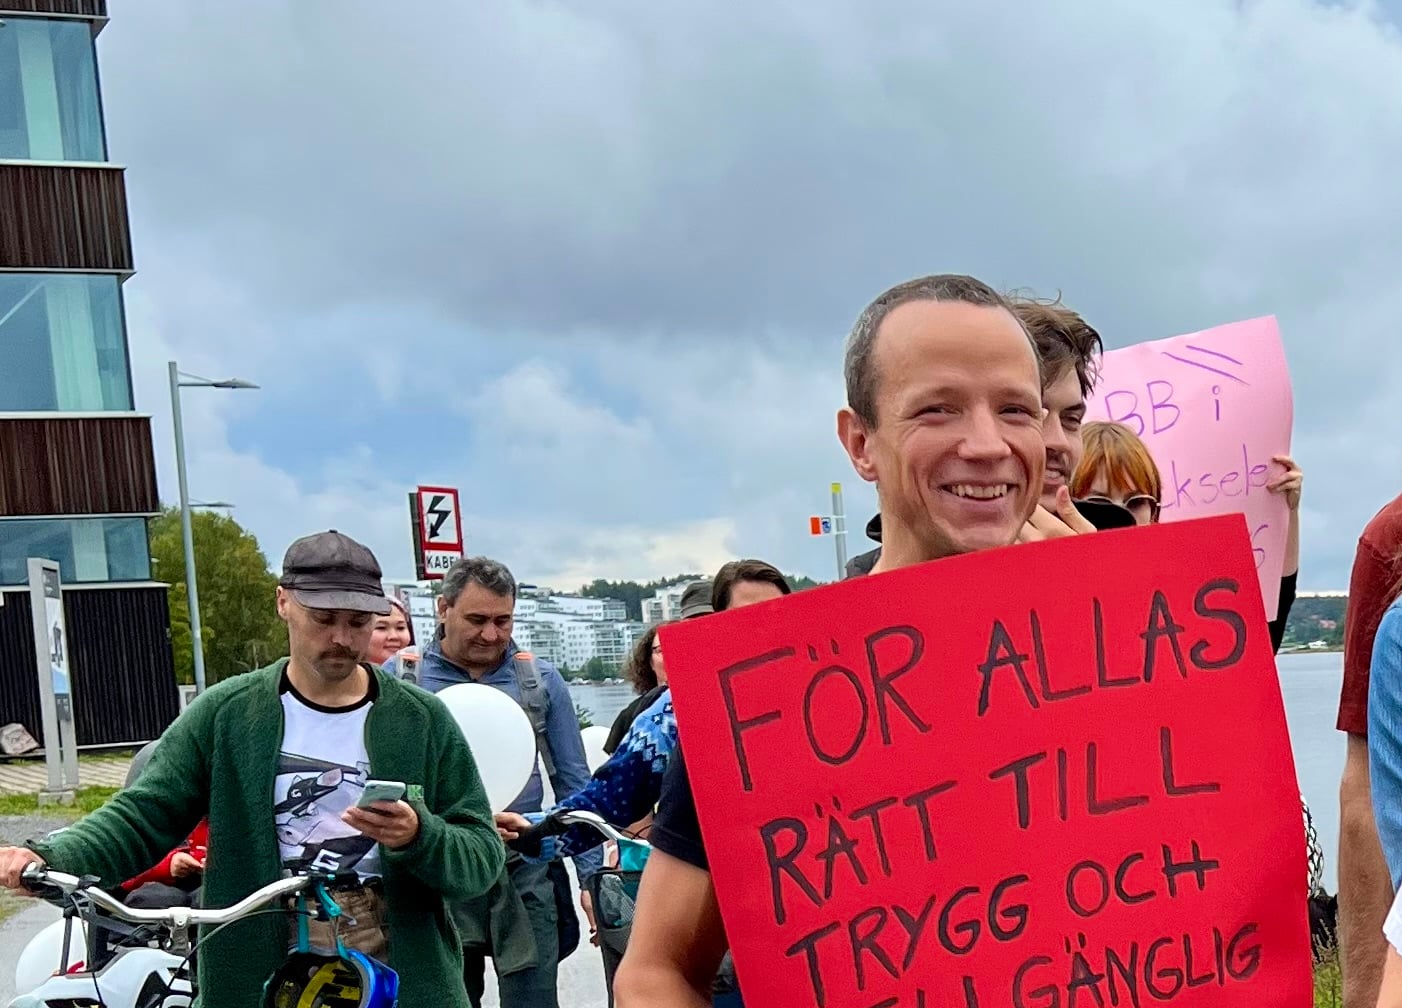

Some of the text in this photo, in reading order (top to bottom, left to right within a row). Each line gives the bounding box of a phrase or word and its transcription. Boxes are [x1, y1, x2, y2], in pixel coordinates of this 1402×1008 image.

[1160, 443, 1268, 508] ksele
[717, 578, 1248, 792] FÖR ALLAS
[759, 726, 1220, 925] RÄTT TILL
[1065, 839, 1220, 917] OCH
